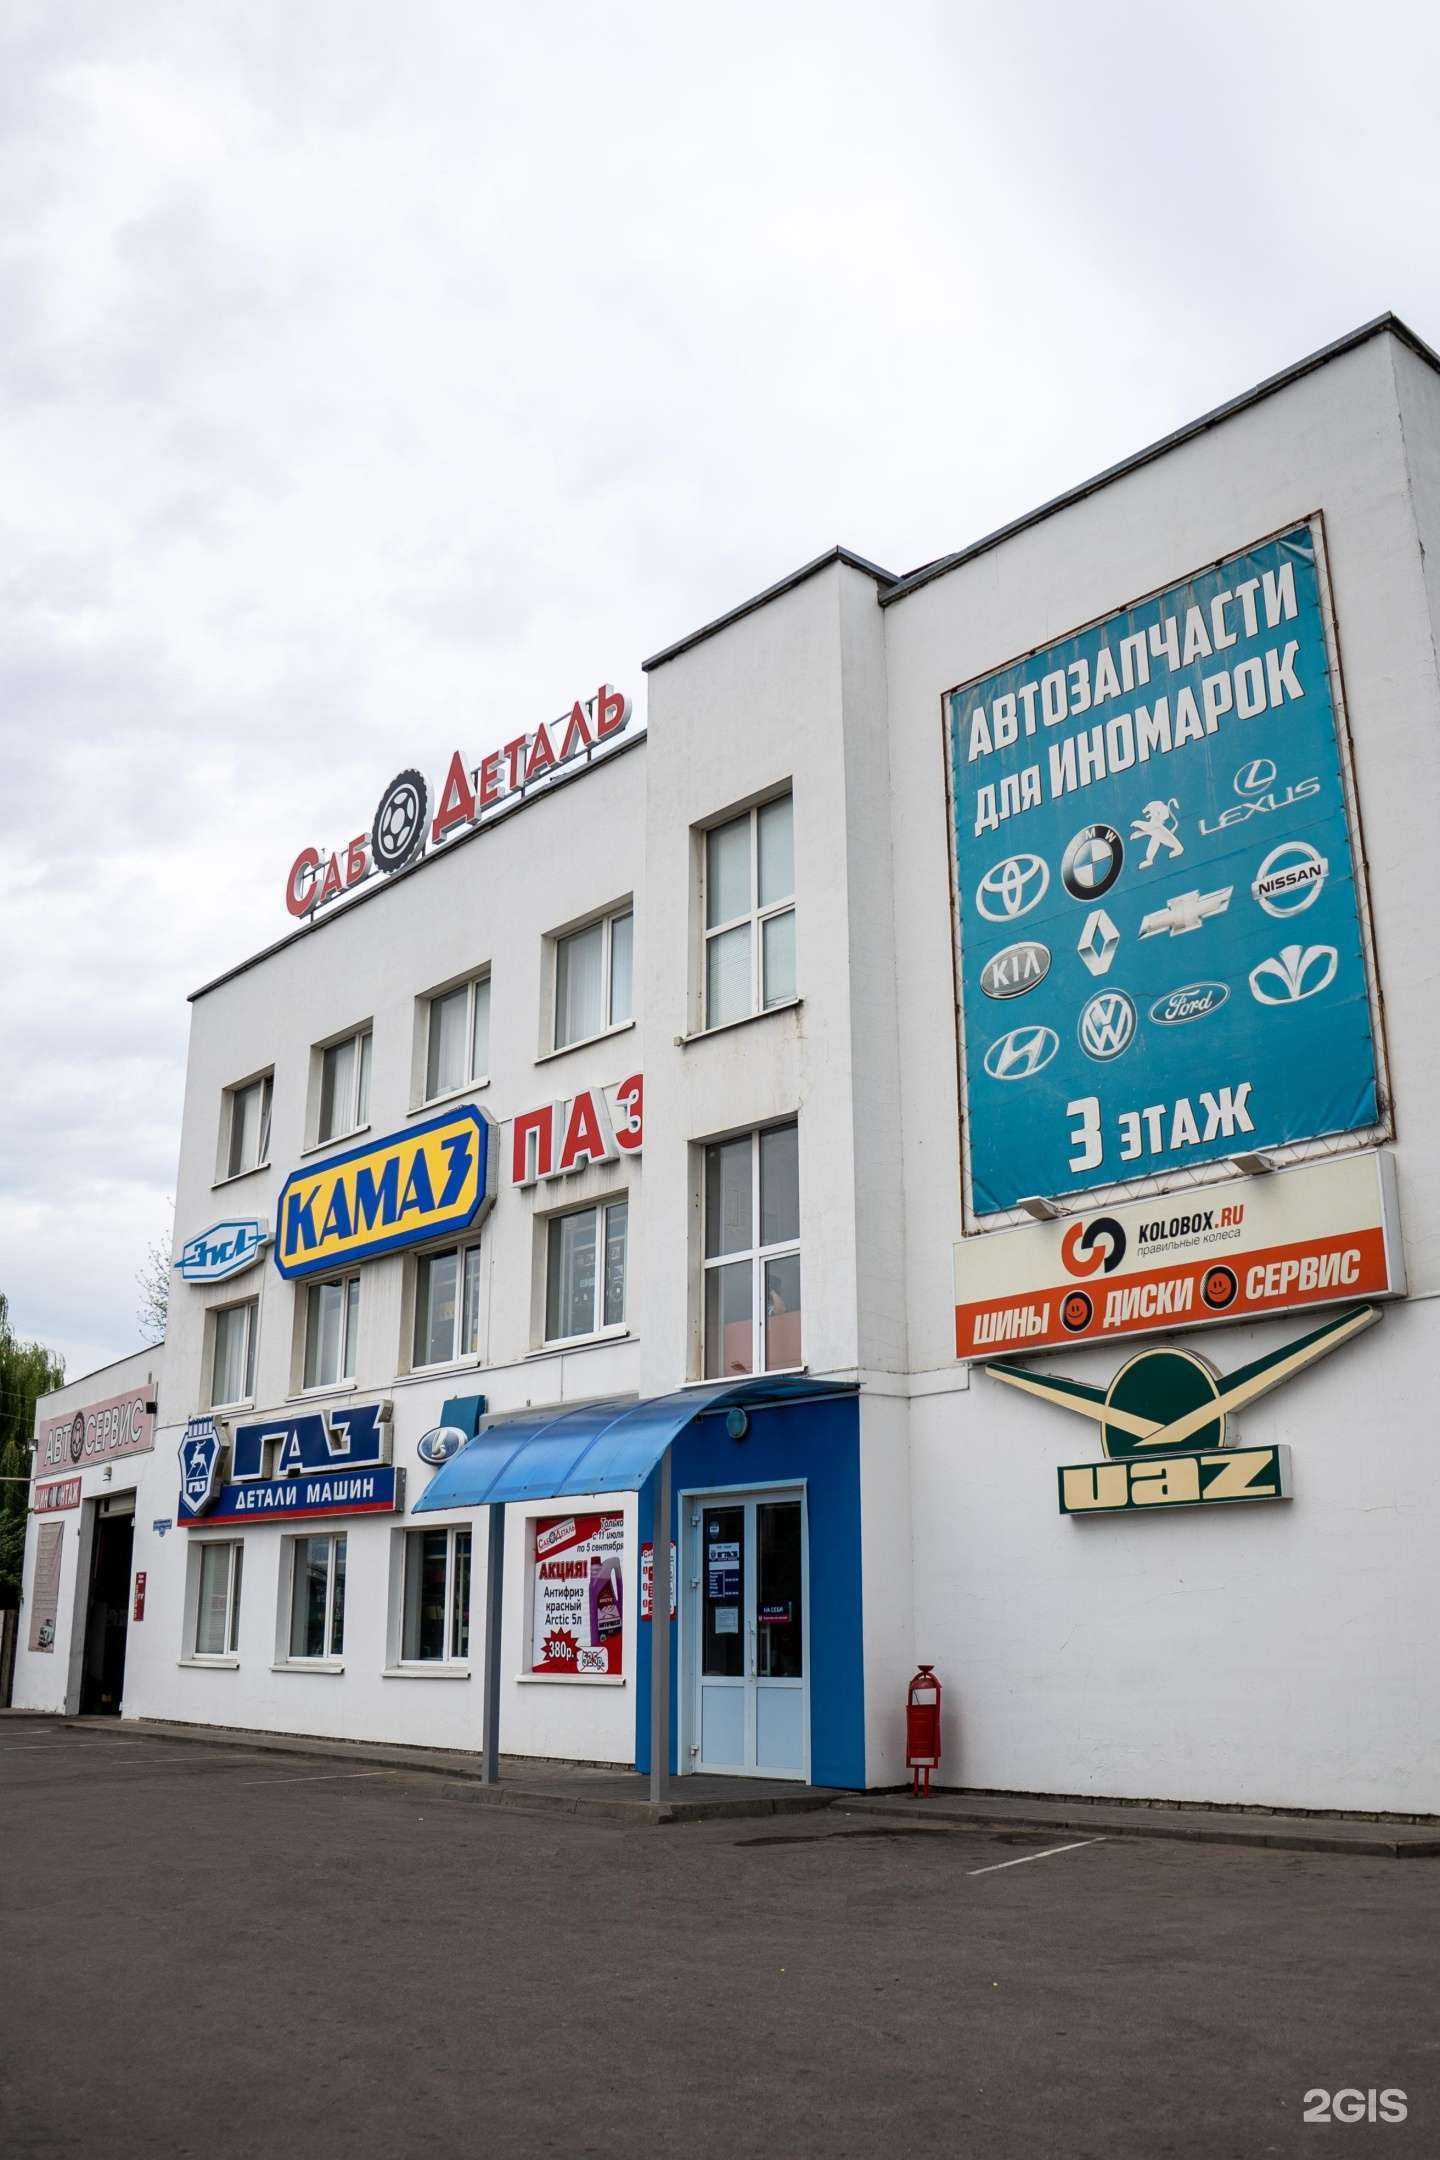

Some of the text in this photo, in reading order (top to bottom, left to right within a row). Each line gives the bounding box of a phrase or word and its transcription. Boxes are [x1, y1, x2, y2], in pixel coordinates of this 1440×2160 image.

[968, 562, 1298, 762] АВТОЗАПЧАСТИ
[974, 640, 1305, 837] ДЛЯ ИНОМАРОК
[1199, 776, 1320, 835] LEXUS
[1258, 864, 1322, 895] NISSAN
[992, 952, 1041, 988] KIA
[1165, 987, 1214, 1017] Ford
[512, 1073, 643, 1184] ПАЗ
[1066, 1082, 1256, 1174] 3 ЭТАЖ
[285, 1130, 474, 1256] КАМАЗ
[1138, 1204, 1244, 1244] KOLOBOX.RU
[1137, 1229, 1241, 1257] правильные колеса
[973, 1248, 1360, 1345] ШИНЫ ДИСКИ СЕРВИС
[232, 1400, 384, 1480] ГАЗ
[235, 1478, 374, 1510] ДЕТАЛИ МАШИН
[599, 1530, 605, 1540] 11
[606, 1531, 623, 1540] июля
[600, 1518, 623, 1529] Только
[586, 1543, 591, 1551] 5
[592, 1542, 624, 1553] сентября
[539, 1560, 588, 1582] АКЦИЯ!
[544, 1586, 584, 1599] Антифриз
[546, 1600, 582, 1613] красный
[545, 1613, 582, 1625] Arctic 5л
[549, 1641, 574, 1661] 380р.
